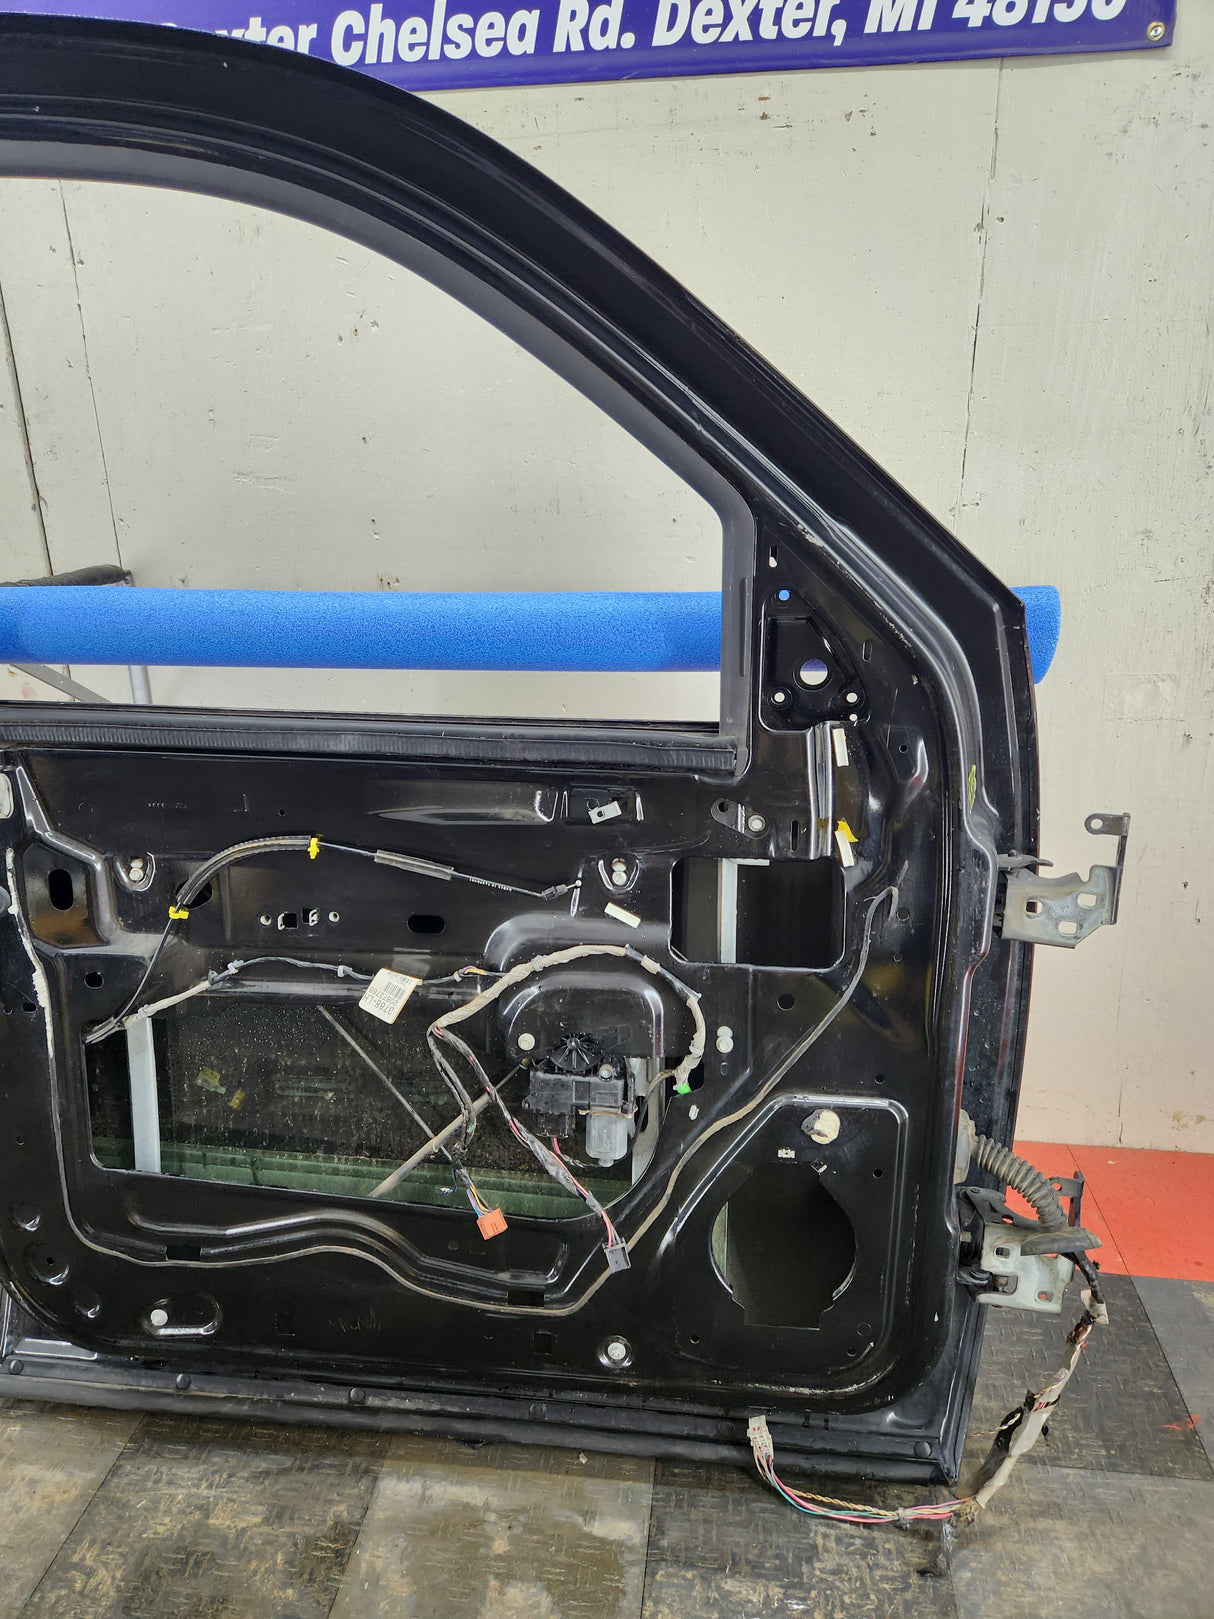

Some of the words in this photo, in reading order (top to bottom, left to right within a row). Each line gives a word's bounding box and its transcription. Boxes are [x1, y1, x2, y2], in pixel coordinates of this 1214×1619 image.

[331, 0, 540, 66] Chelsea
[552, 0, 635, 52] Rd.
[651, 0, 847, 46] Dexter,
[863, 0, 937, 34] MI
